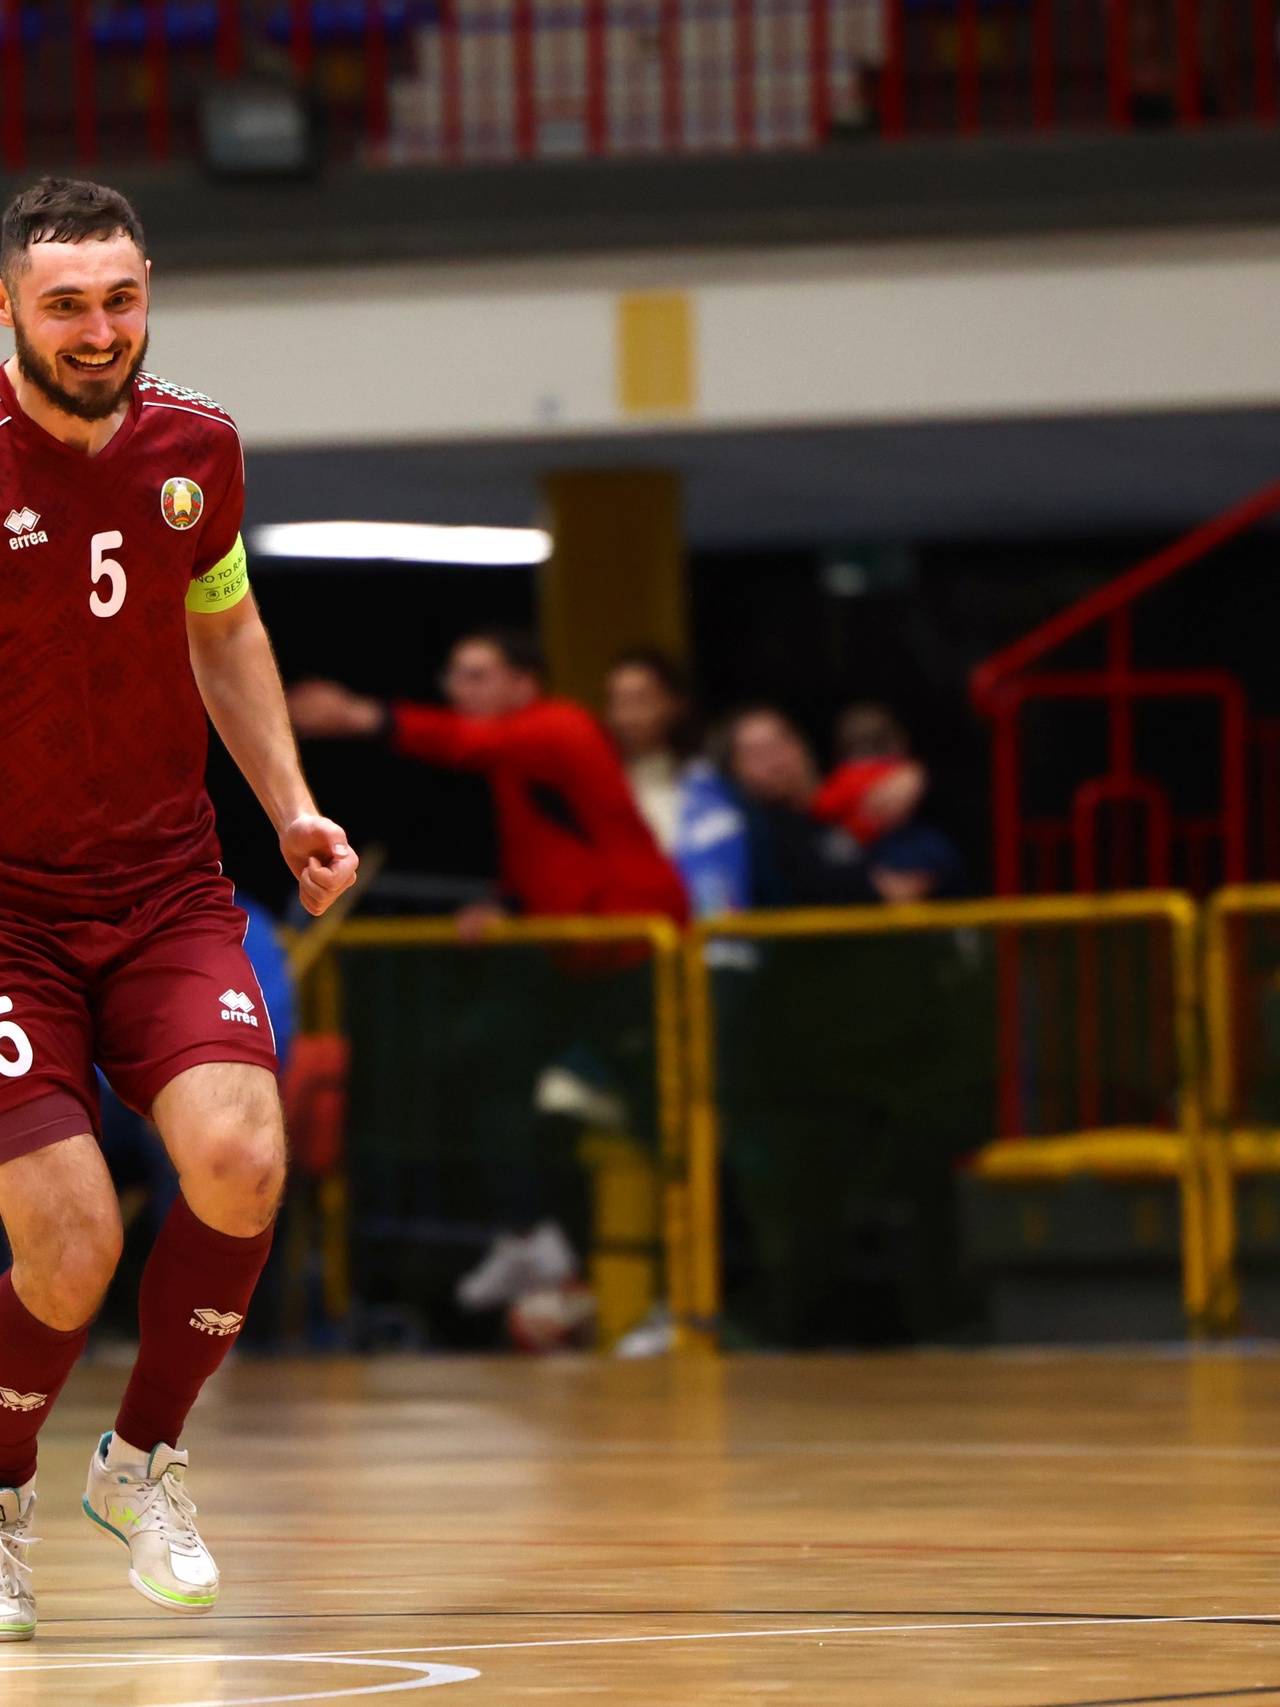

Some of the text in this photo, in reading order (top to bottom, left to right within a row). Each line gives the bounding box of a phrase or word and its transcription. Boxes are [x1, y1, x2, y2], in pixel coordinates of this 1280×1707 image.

[9, 530, 49, 551] errea
[89, 530, 127, 618] 5
[217, 568, 232, 581] TO
[221, 1009, 259, 1027] errea
[189, 1317, 241, 1337] errea
